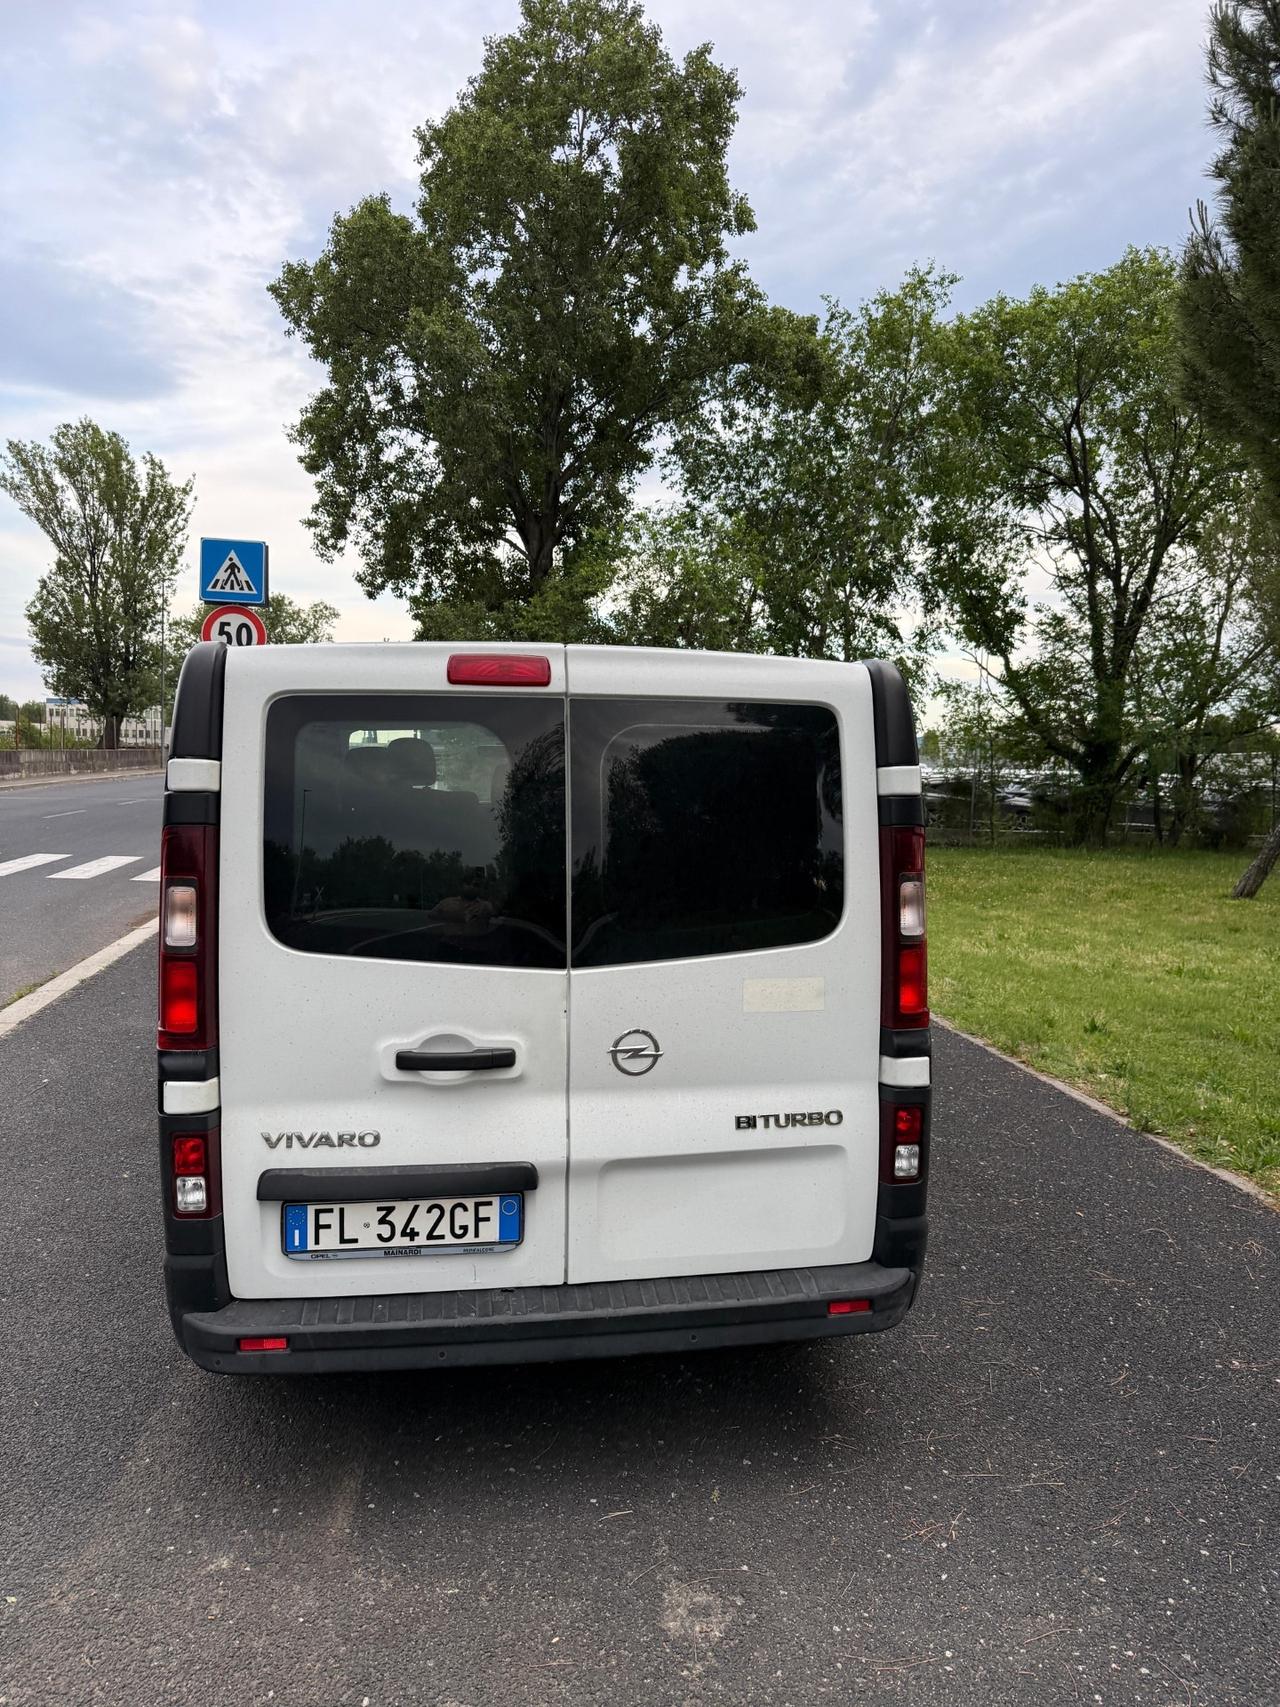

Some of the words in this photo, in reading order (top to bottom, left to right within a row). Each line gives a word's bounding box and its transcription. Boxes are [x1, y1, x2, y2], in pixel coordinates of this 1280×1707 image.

[218, 621, 253, 646] 50
[735, 1109, 843, 1130] BITURBO
[261, 1130, 381, 1149] VIVARO
[314, 1207, 358, 1245] FL
[376, 1201, 493, 1243] 342GF
[383, 1248, 421, 1256] MAINARDI
